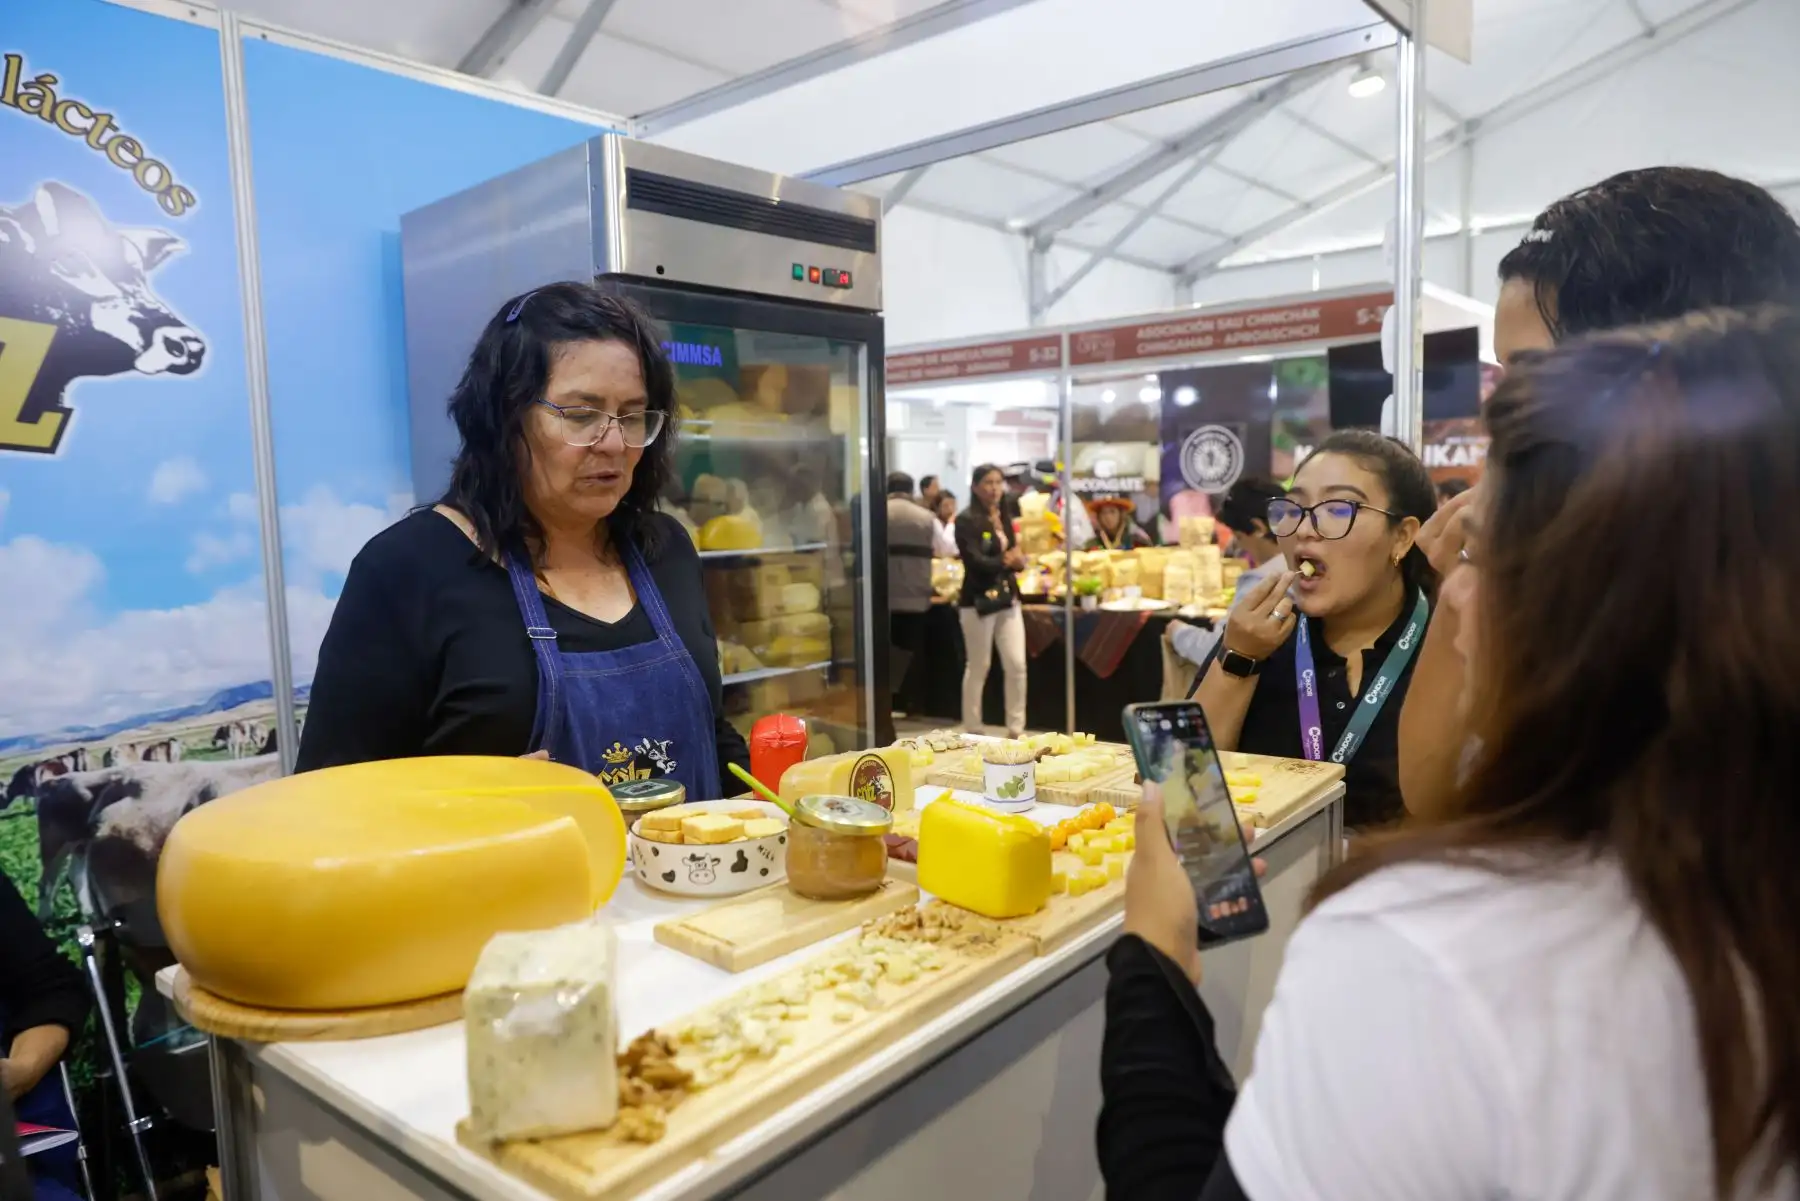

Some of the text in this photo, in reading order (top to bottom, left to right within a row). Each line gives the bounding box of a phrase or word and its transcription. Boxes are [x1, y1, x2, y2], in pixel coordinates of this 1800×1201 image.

[0, 53, 196, 217] lácteos
[1364, 675, 1388, 704] CONDOR
[1308, 726, 1321, 760] CONDOR
[1332, 732, 1355, 763] CONDOR
